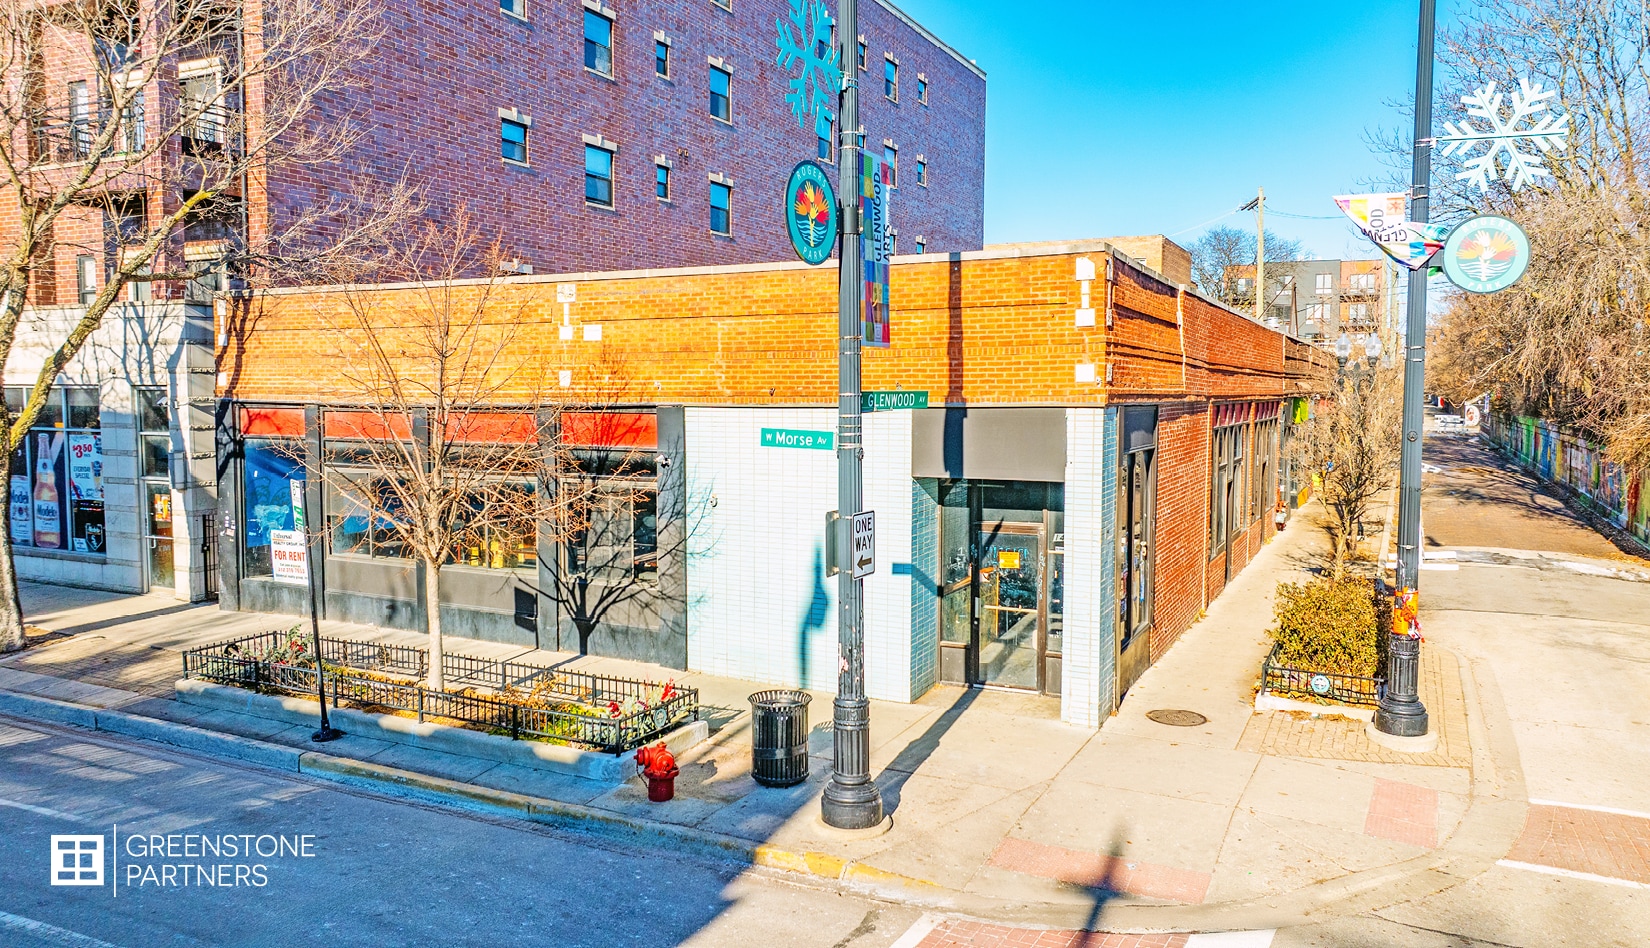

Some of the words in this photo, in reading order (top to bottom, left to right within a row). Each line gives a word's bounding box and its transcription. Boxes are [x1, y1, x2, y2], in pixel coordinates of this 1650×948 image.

[796, 165, 828, 188] ROGERS
[872, 172, 882, 262] GLENWOOD
[1461, 218, 1514, 233] ROGERS
[883, 223, 891, 262] ARTS
[802, 246, 824, 261] PARK
[1467, 281, 1502, 291] PARK
[868, 393, 915, 407] GLENWOOD
[765, 432, 773, 441] W
[775, 431, 813, 446] Morse
[817, 436, 828, 445] Av
[855, 517, 872, 534] ONE
[855, 534, 872, 552] WAY
[274, 550, 287, 561] FOR
[289, 552, 306, 562] RENT
